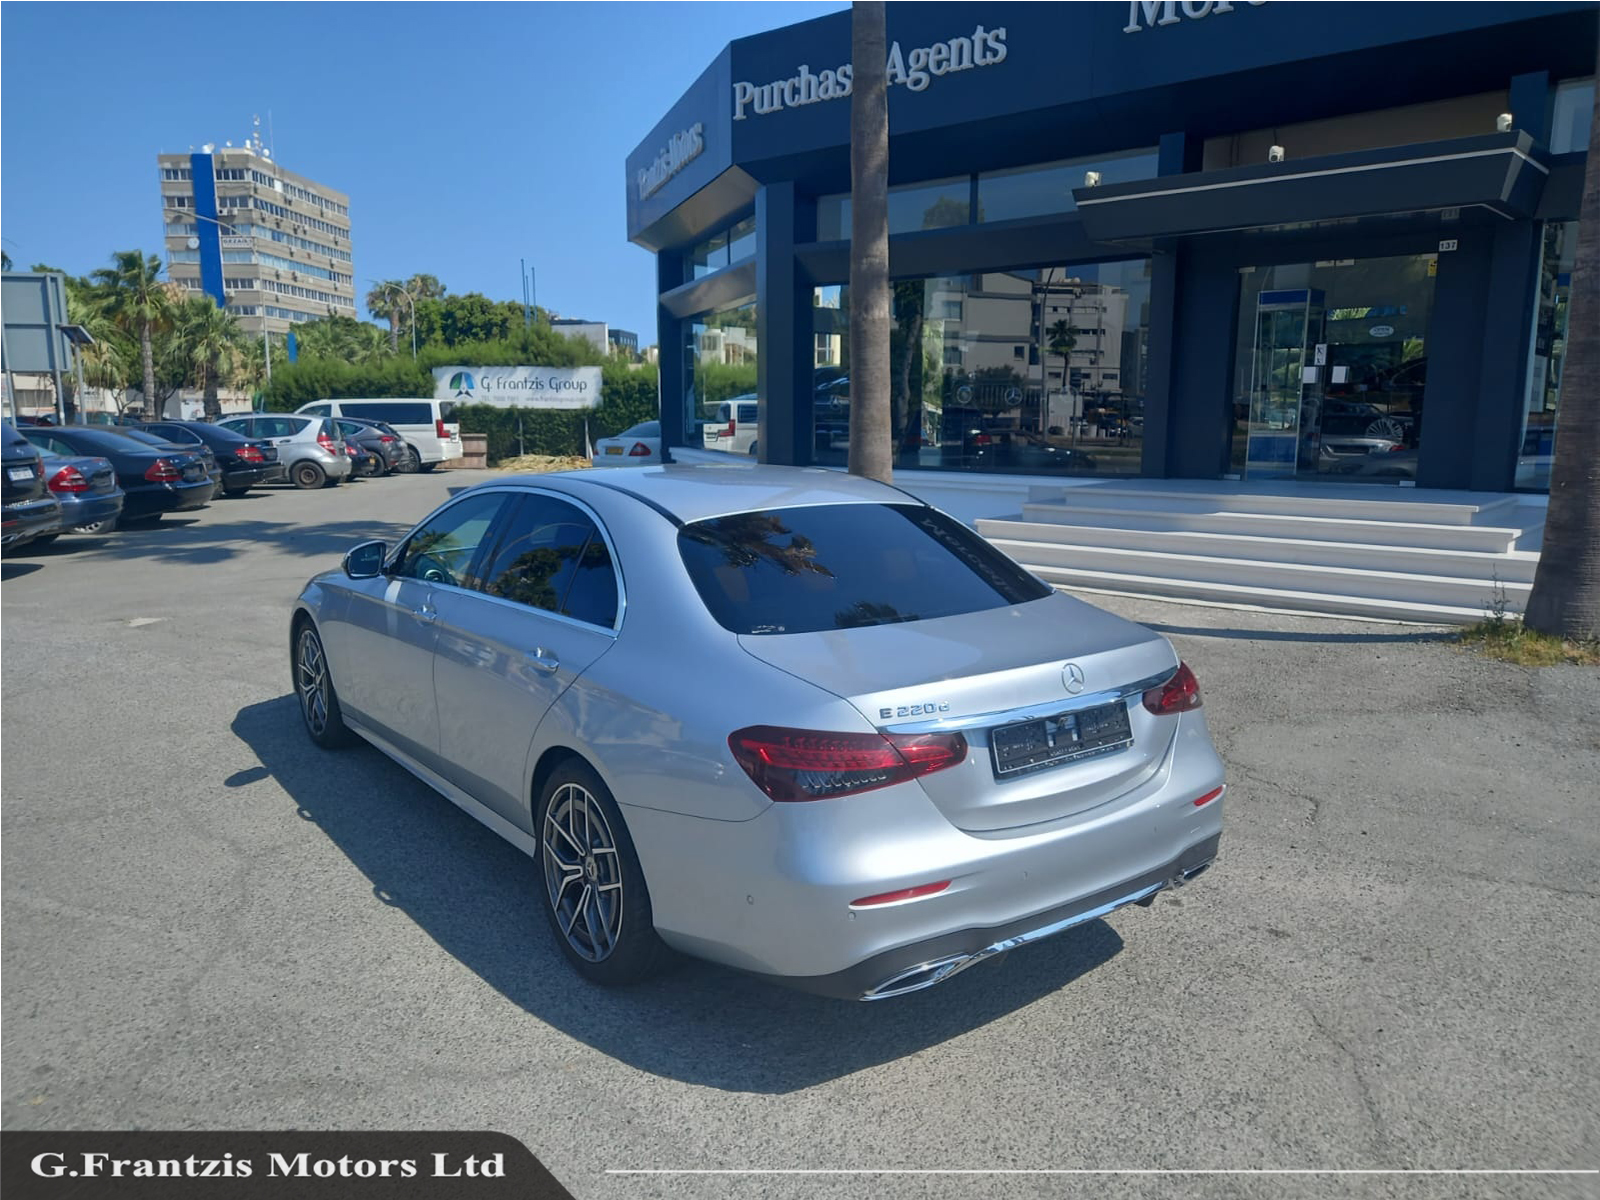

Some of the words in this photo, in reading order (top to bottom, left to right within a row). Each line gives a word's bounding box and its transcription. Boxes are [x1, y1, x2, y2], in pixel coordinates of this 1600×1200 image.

[733, 64, 853, 120] Purchas
[886, 24, 1008, 92] Agents
[497, 376, 545, 390] Frantzis
[549, 376, 588, 393] Group
[879, 707, 893, 719] E
